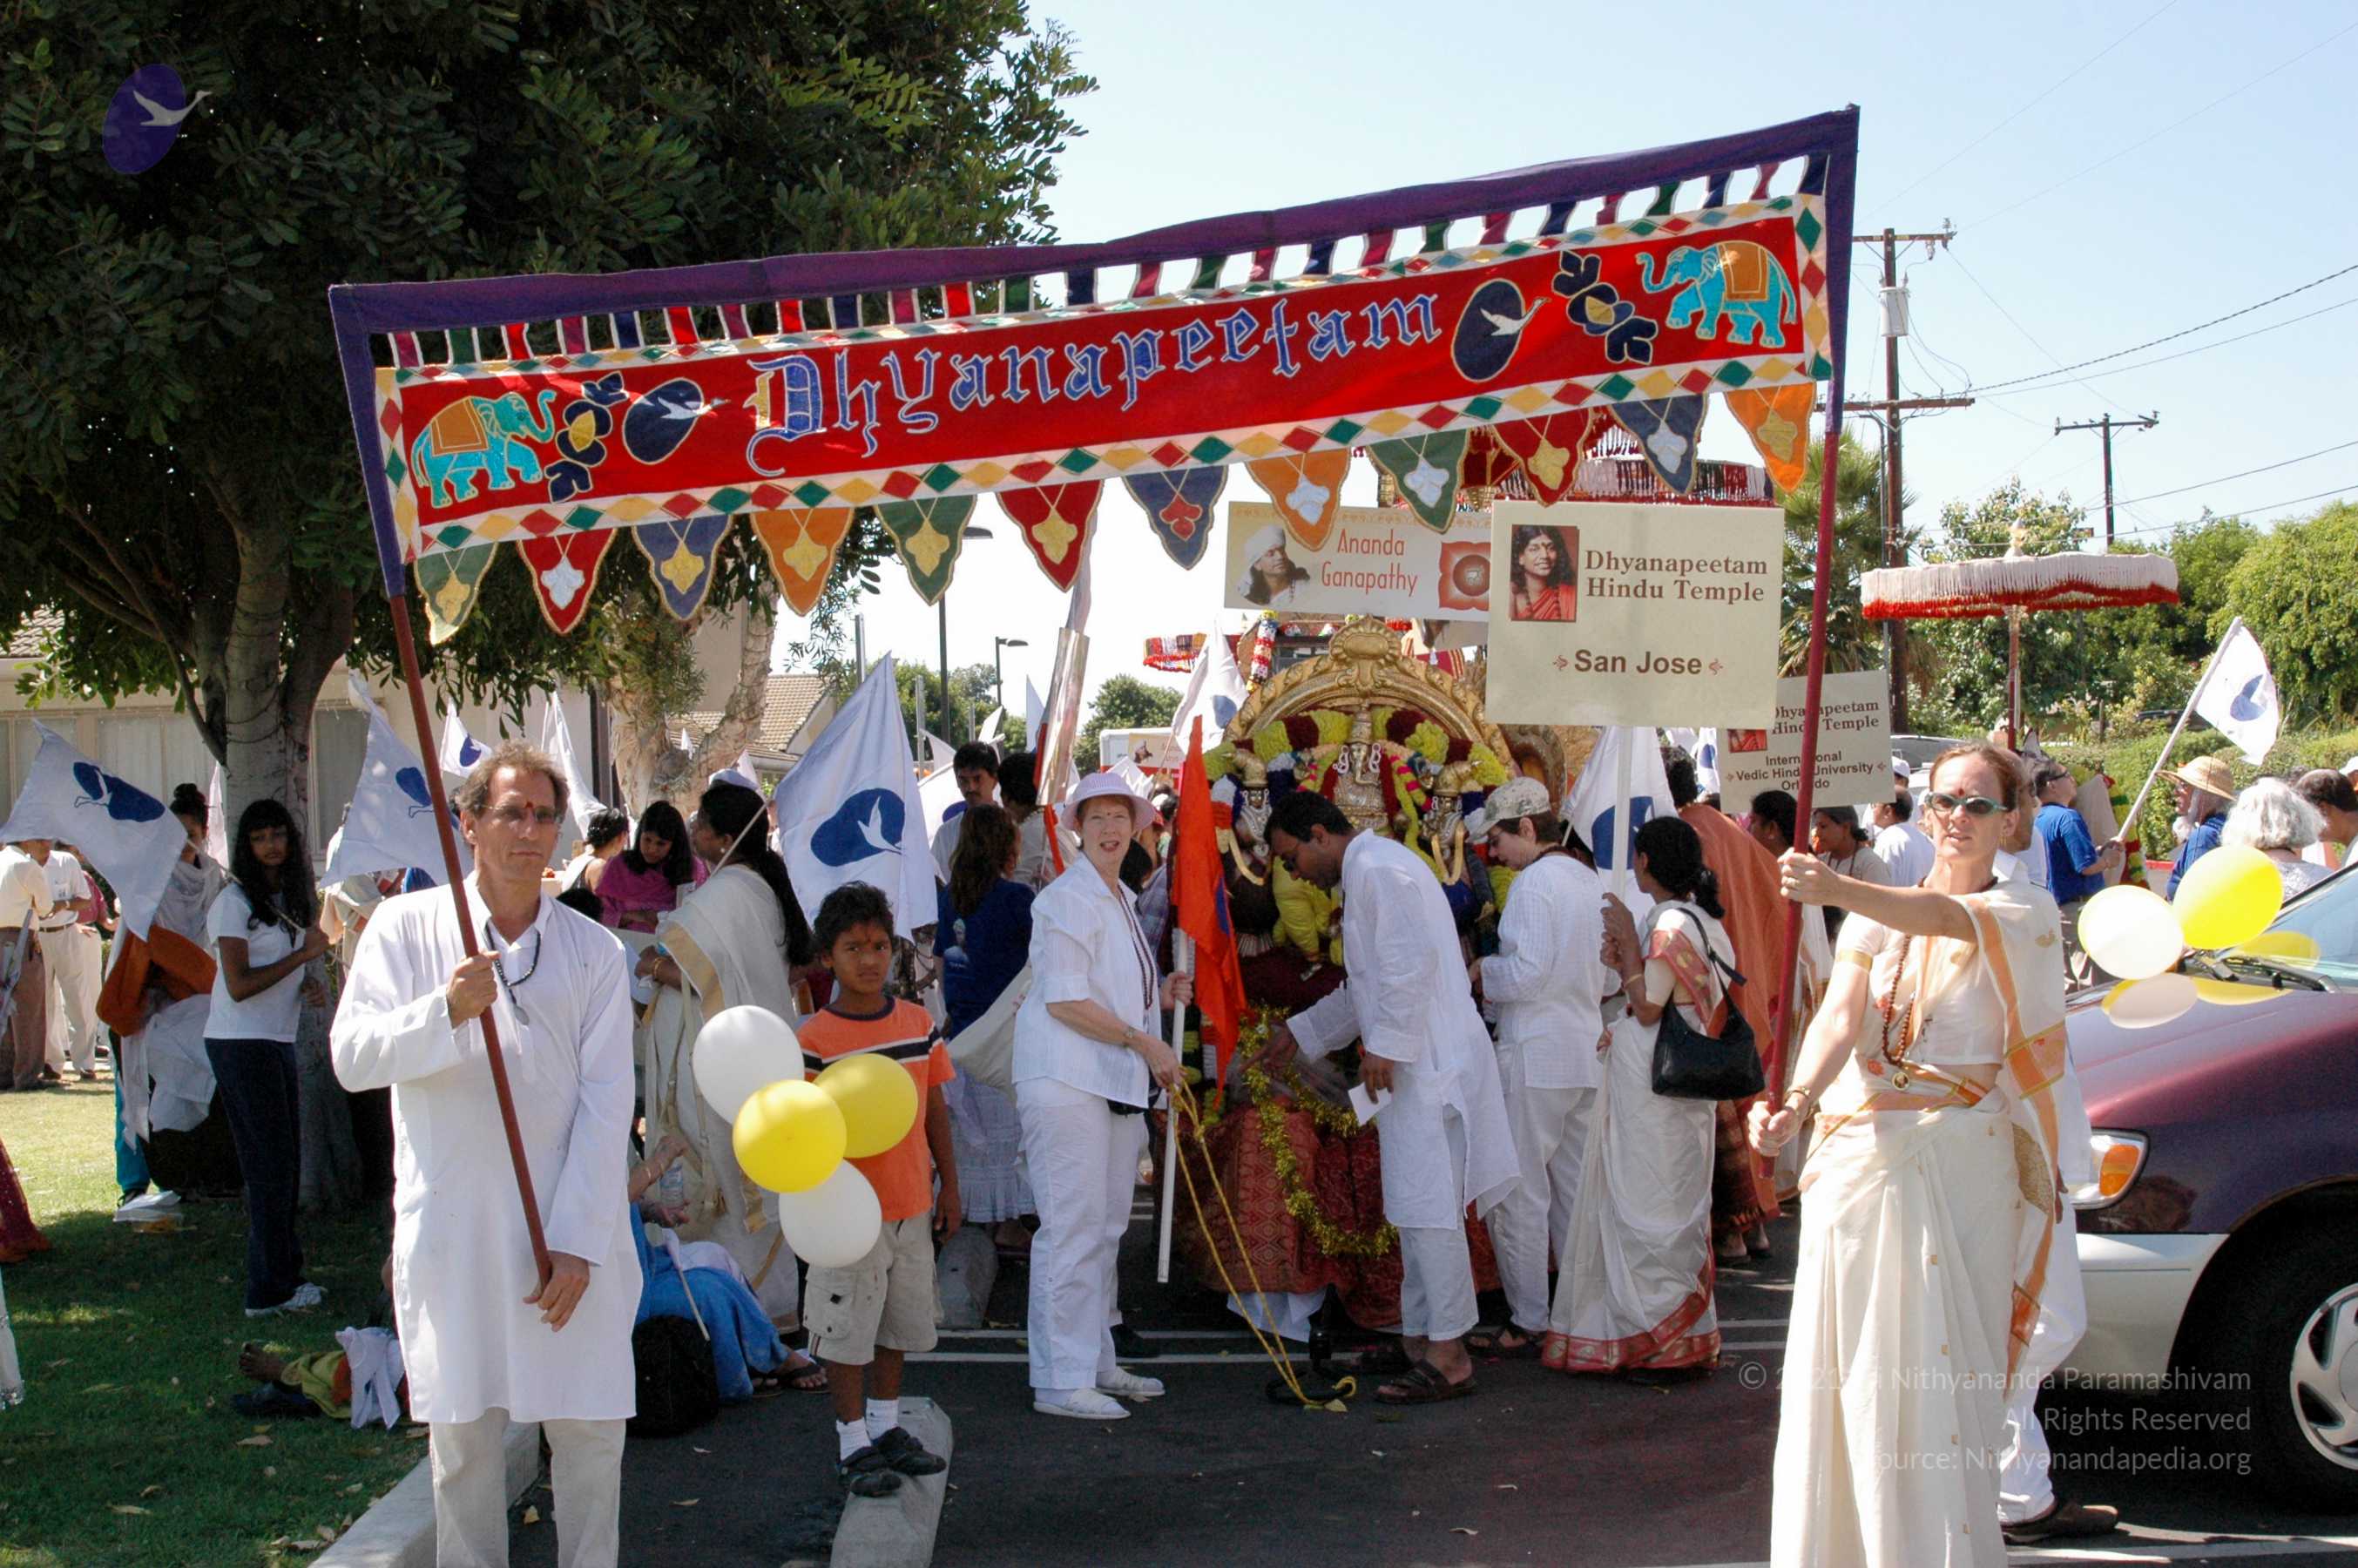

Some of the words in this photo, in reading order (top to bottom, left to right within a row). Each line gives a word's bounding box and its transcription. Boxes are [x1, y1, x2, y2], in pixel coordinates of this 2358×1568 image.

[742, 293, 1443, 476] Dhyanapeetam
[1336, 528, 1405, 556] Ananda
[1584, 550, 1768, 577] Dhyanapeetam
[1321, 561, 1418, 597] Ganapathy
[1586, 577, 1664, 599] Hindu
[1673, 579, 1765, 605] Temple
[1574, 649, 1627, 673] San
[1636, 652, 1702, 675] Jose
[1775, 700, 1880, 720] hyapeetam
[1772, 721, 1807, 734] Hin
[1822, 715, 1880, 732] Temple
[1766, 750, 1842, 766] Internonal
[1736, 768, 1769, 781] Vedic
[1772, 767, 1801, 779] Hind
[1781, 778, 1830, 791] Orldo
